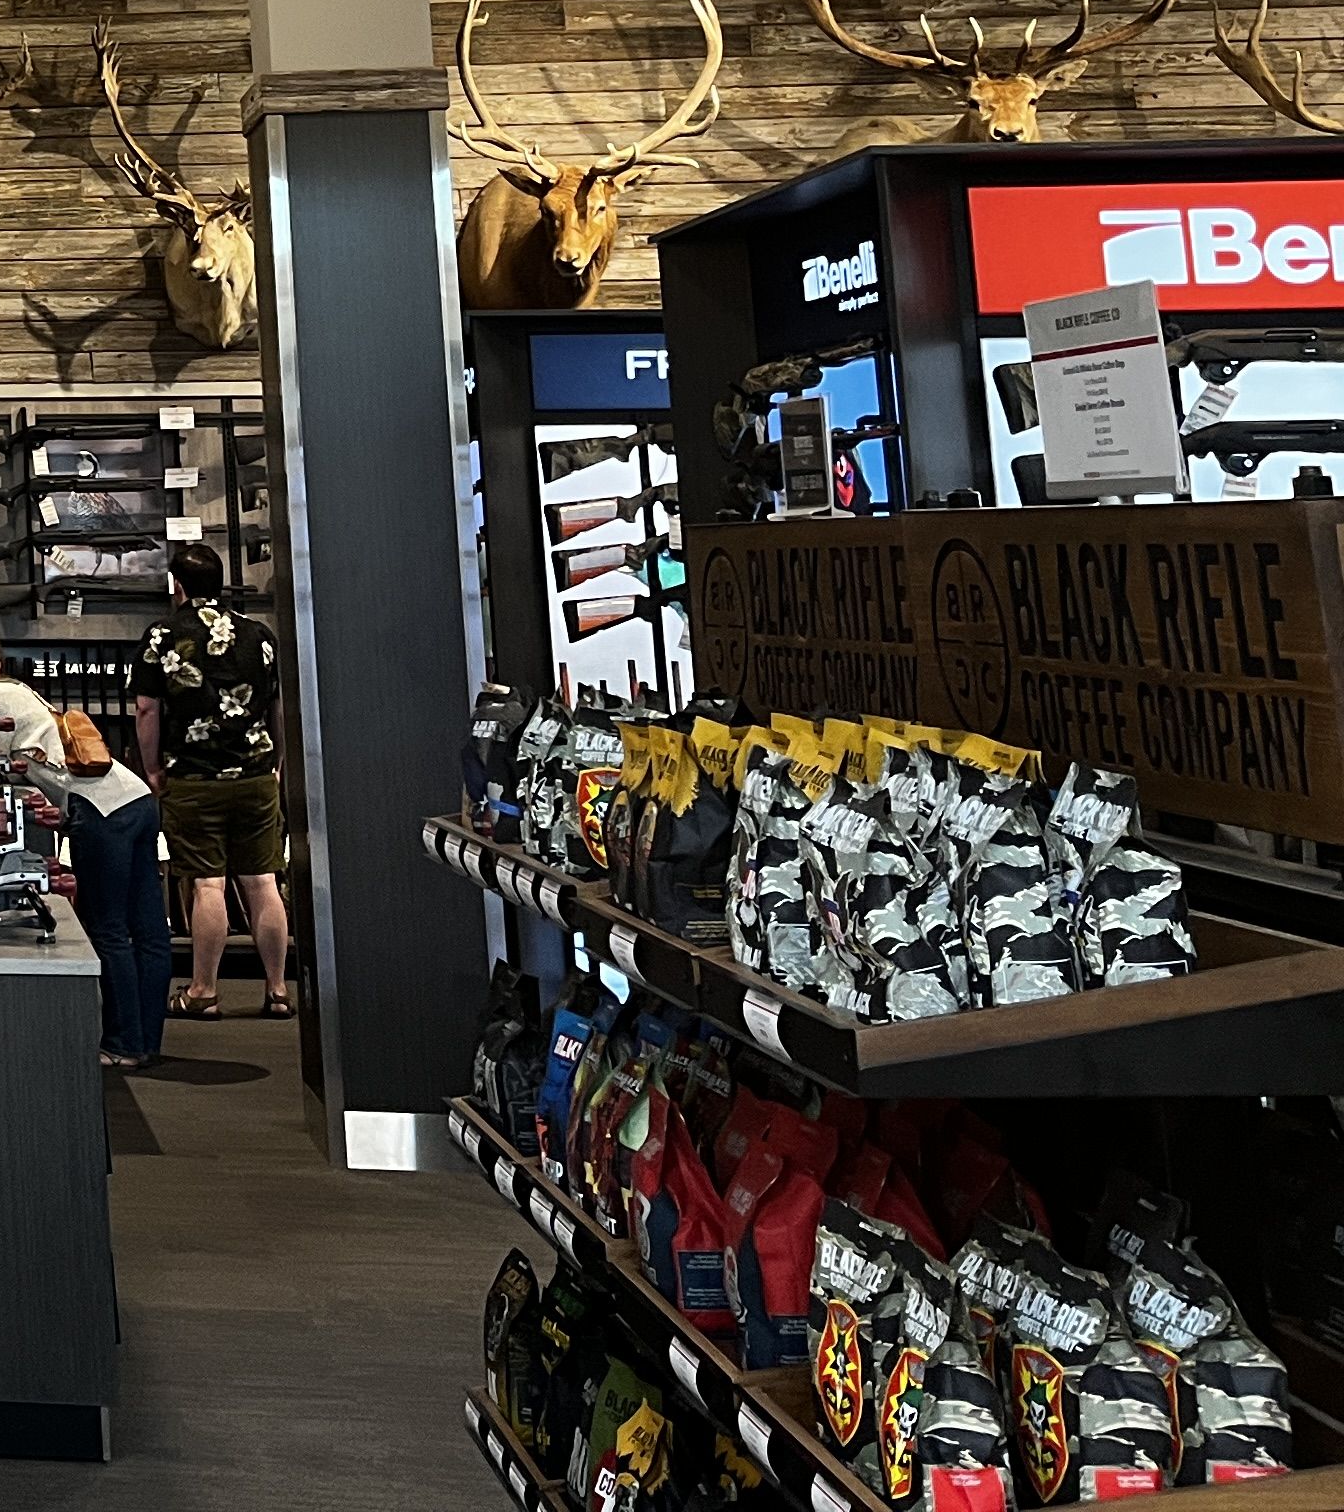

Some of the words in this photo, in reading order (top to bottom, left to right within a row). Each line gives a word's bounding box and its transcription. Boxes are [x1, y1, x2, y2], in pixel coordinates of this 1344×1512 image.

[815, 240, 879, 300] Benelli
[746, 545, 821, 638] BLACK
[829, 544, 914, 645] RIFLE
[1003, 542, 1145, 667] BLACK
[1144, 542, 1298, 683] RIFLE
[1019, 668, 1137, 770] COFFEE
[1135, 680, 1312, 798] COMPANY
[1016, 1287, 1058, 1327] BLACK
[1054, 1301, 1100, 1346] RIFLE
[1128, 1280, 1184, 1327] BLACK
